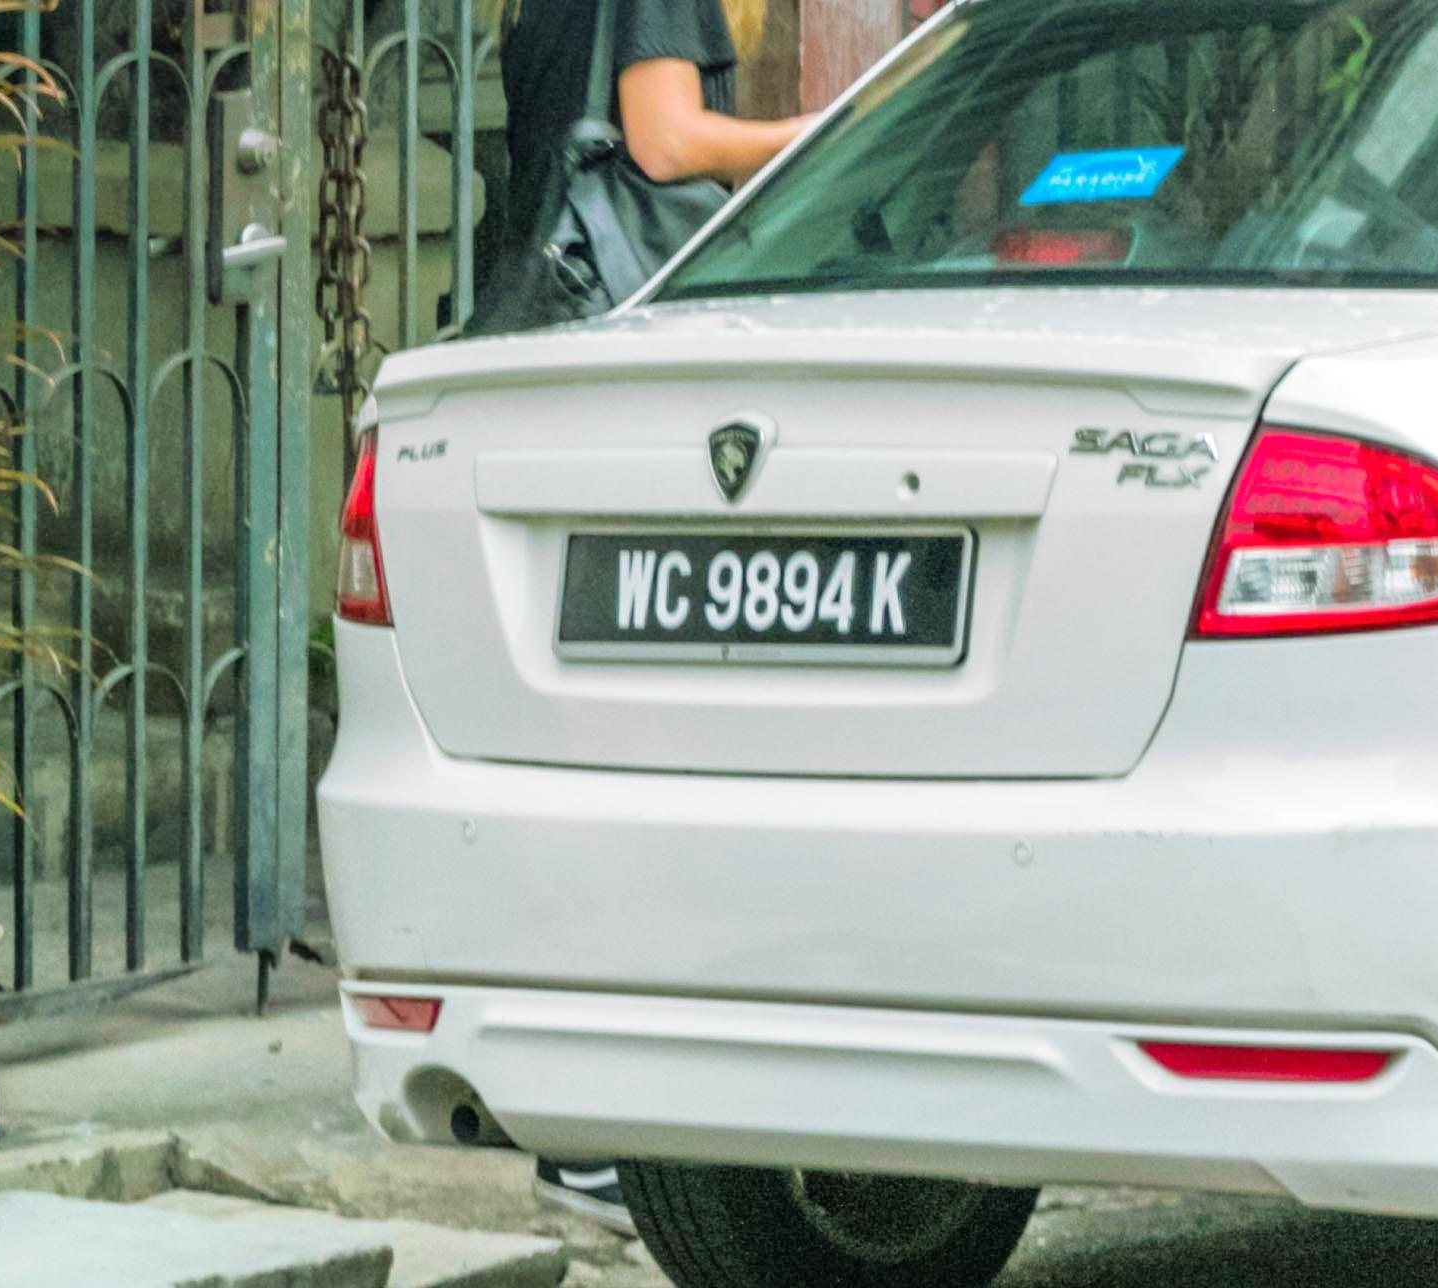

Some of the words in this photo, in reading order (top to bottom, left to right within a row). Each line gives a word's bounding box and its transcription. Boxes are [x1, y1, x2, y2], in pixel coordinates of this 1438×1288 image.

[1069, 427, 1219, 462] SAGA
[1117, 464, 1210, 489] FLX
[616, 549, 691, 631] WC
[705, 550, 854, 633] 9894
[870, 551, 911, 635] K
